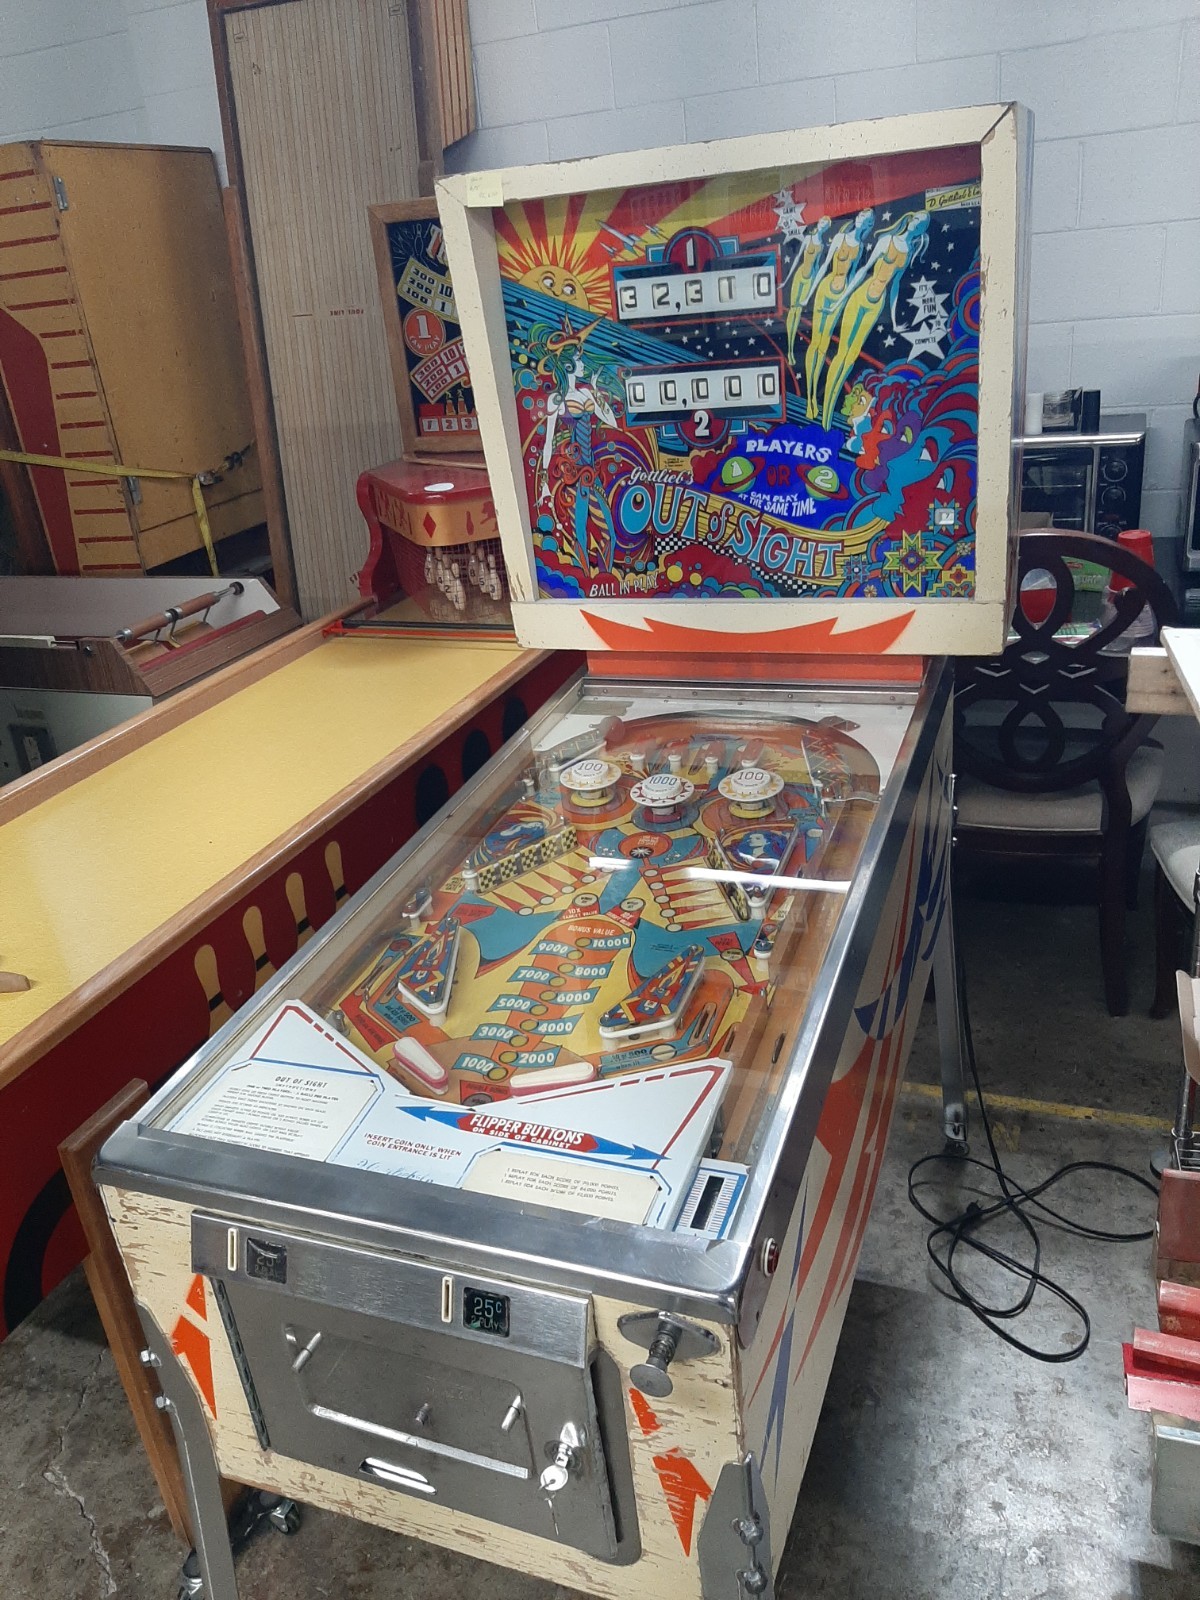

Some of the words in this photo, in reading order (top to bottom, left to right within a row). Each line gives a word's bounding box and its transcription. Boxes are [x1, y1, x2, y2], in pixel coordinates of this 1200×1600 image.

[782, 206, 796, 215] GAME
[687, 237, 696, 267] 1
[412, 267, 435, 285] 300
[439, 283, 453, 298] 10
[406, 287, 428, 305] 100
[408, 277, 432, 295] 200
[440, 301, 446, 313] 1
[922, 296, 936, 304] MORE
[923, 304, 937, 314] FUN
[416, 315, 431, 339] 1
[424, 335, 440, 351] PLAY
[914, 336, 936, 345] COMPETE
[416, 358, 439, 379] 300
[443, 347, 457, 363] 10
[424, 367, 444, 387] 200
[453, 364, 462, 375] 1
[431, 378, 448, 394] 100
[445, 419, 453, 430] 2
[465, 418, 472, 430] 3
[694, 410, 710, 437] 2
[746, 439, 832, 463] PLAYERS
[628, 466, 695, 486] Gottlieb's
[731, 461, 743, 478] 1
[766, 464, 791, 488] OR
[814, 469, 834, 488] 2
[751, 491, 771, 501] CAN
[773, 493, 798, 503] PLAY
[738, 493, 749, 502] AT
[750, 496, 762, 509] THE
[764, 502, 789, 517] SAME
[792, 498, 817, 517] TIME
[620, 484, 708, 541] OUT
[707, 503, 735, 543] of
[728, 513, 843, 578] SIGHT
[445, 585, 451, 593] 2
[589, 583, 617, 597] BALL
[619, 580, 630, 595] IN
[634, 572, 659, 592] PLAY
[578, 762, 603, 772] 100
[649, 776, 678, 786] 1000
[737, 771, 764, 781] 100
[567, 925, 591, 933] BONUS
[593, 928, 615, 936] VALUE
[538, 942, 569, 953] 9000
[517, 969, 550, 981] 7000
[574, 967, 606, 976] 8000
[497, 998, 531, 1010] 5000
[556, 992, 591, 1003] 6000
[478, 1026, 514, 1039] 3000
[538, 1022, 573, 1033] 4000
[461, 1057, 494, 1072] 1000
[518, 1052, 555, 1064] 2000
[304, 1080, 328, 1088] SIGHT
[470, 1114, 523, 1134] FLIPPER
[521, 1121, 585, 1145] BUTTONS
[364, 1133, 393, 1143] INSERT
[394, 1139, 413, 1147] COIN
[414, 1142, 435, 1151] ONLY
[437, 1147, 462, 1156] WHEN
[489, 1129, 510, 1138] SIDE
[531, 1137, 572, 1149] CABINET
[366, 1139, 386, 1148] COIN
[387, 1143, 430, 1156] ENTRANCE
